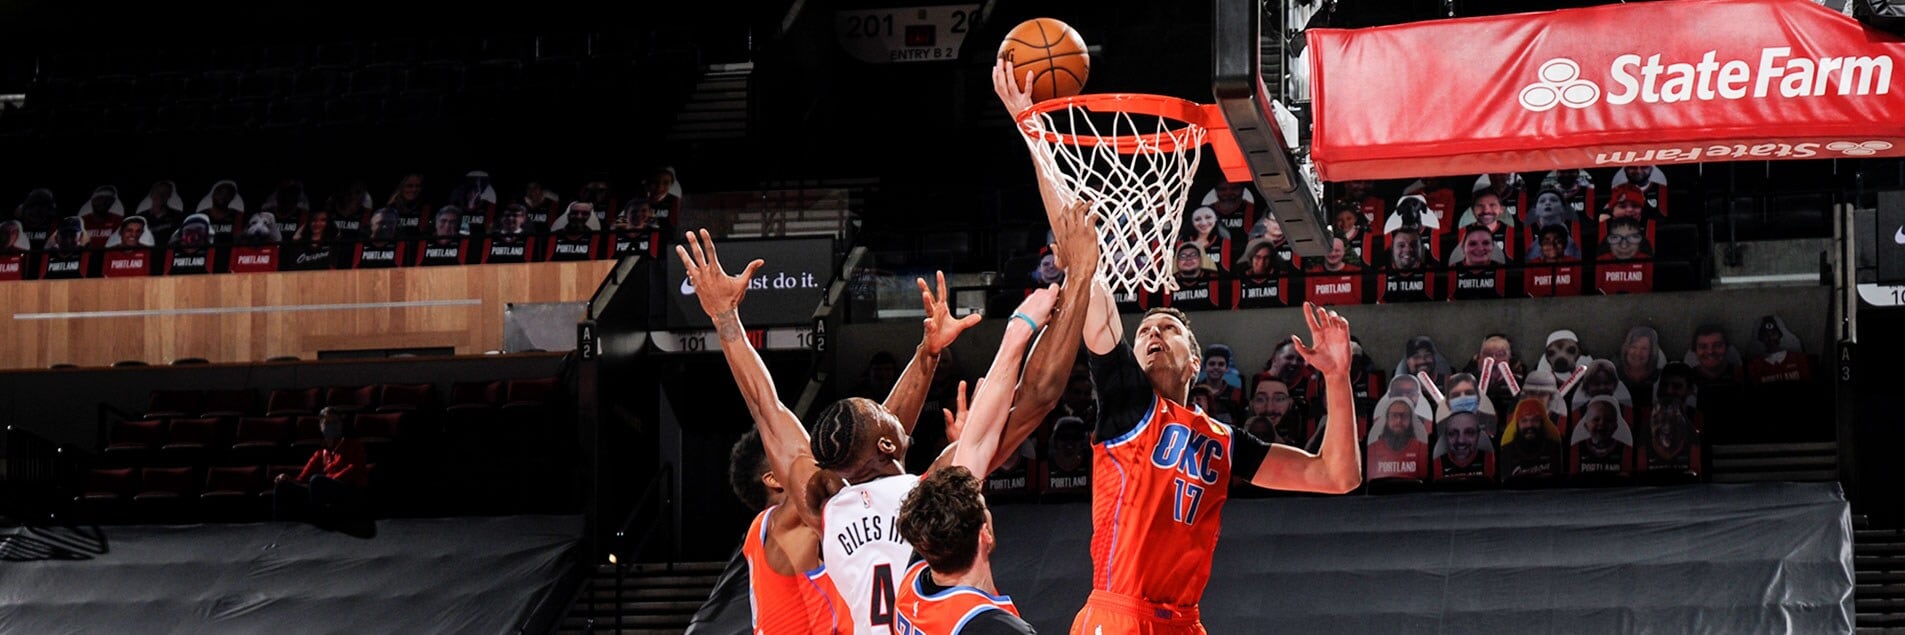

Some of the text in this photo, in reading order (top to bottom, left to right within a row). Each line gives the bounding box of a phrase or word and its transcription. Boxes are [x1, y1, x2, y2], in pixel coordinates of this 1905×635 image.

[847, 14, 893, 38] 201
[890, 48, 953, 60] ENTRY B 2
[747, 272, 818, 290] ust do it.
[1534, 274, 1571, 286] PORTAND
[1605, 271, 1643, 282] PORTLAND
[1315, 283, 1352, 295] PORTLAND
[1387, 281, 1424, 293] POTLAND
[1458, 277, 1495, 290] PORTLAND
[1172, 288, 1208, 301] PORTLAND
[680, 336, 705, 352] 101
[1151, 423, 1223, 485] OKC
[1378, 461, 1417, 474] PORTLAND
[1174, 477, 1205, 526] 17
[838, 515, 882, 556] GILES
